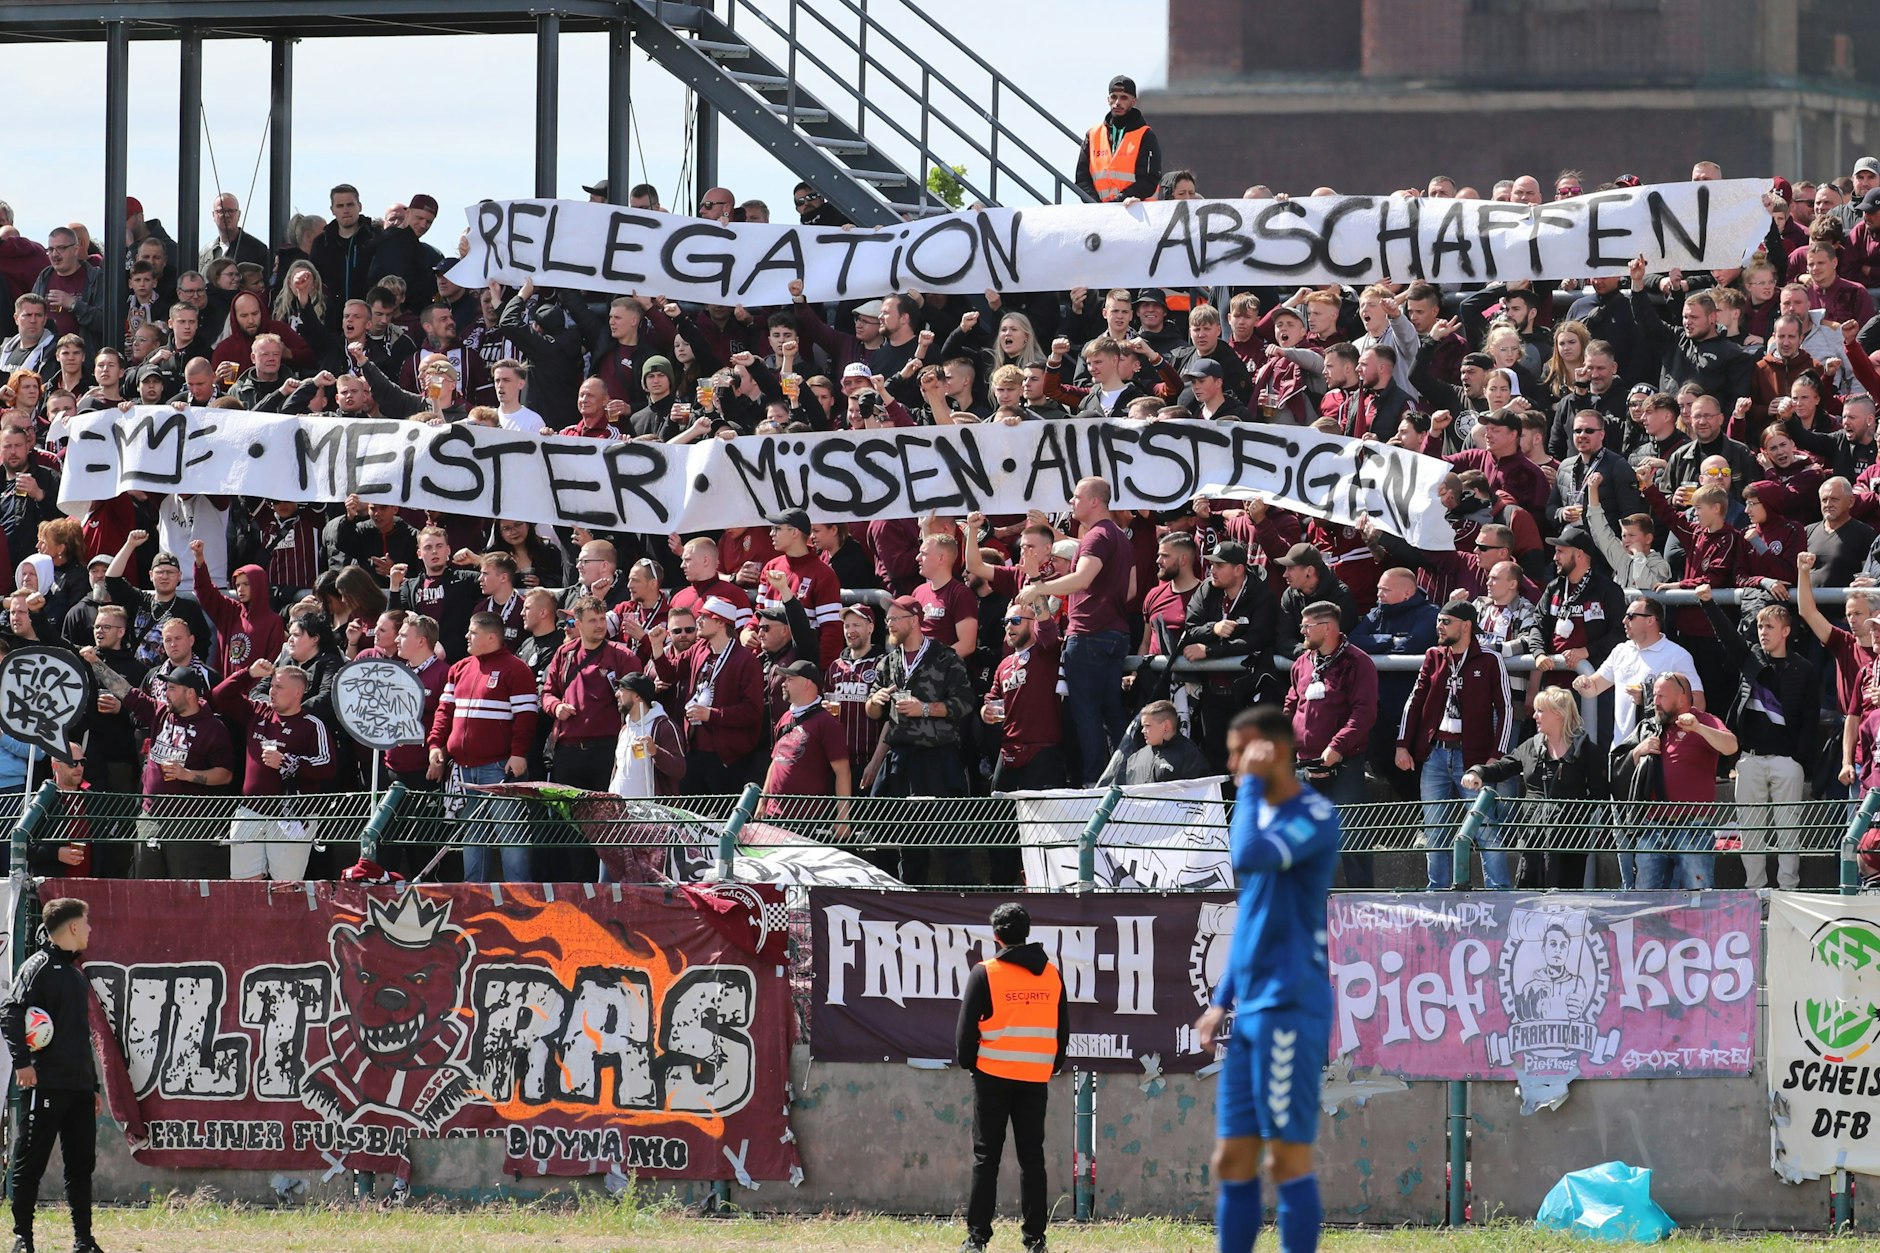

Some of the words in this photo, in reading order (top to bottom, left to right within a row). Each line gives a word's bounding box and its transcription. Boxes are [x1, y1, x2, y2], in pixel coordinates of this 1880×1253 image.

[1149, 185, 1710, 279] ABSCHAFFEN
[360, 664, 396, 678] DAS
[835, 682, 868, 695] DWB
[6, 690, 60, 741] DFB
[822, 904, 1158, 1016] FRAKTN-H
[1005, 991, 1051, 1002] SECURITY
[1066, 1033, 1133, 1059] SSBALL
[1811, 1107, 1872, 1139] DFB
